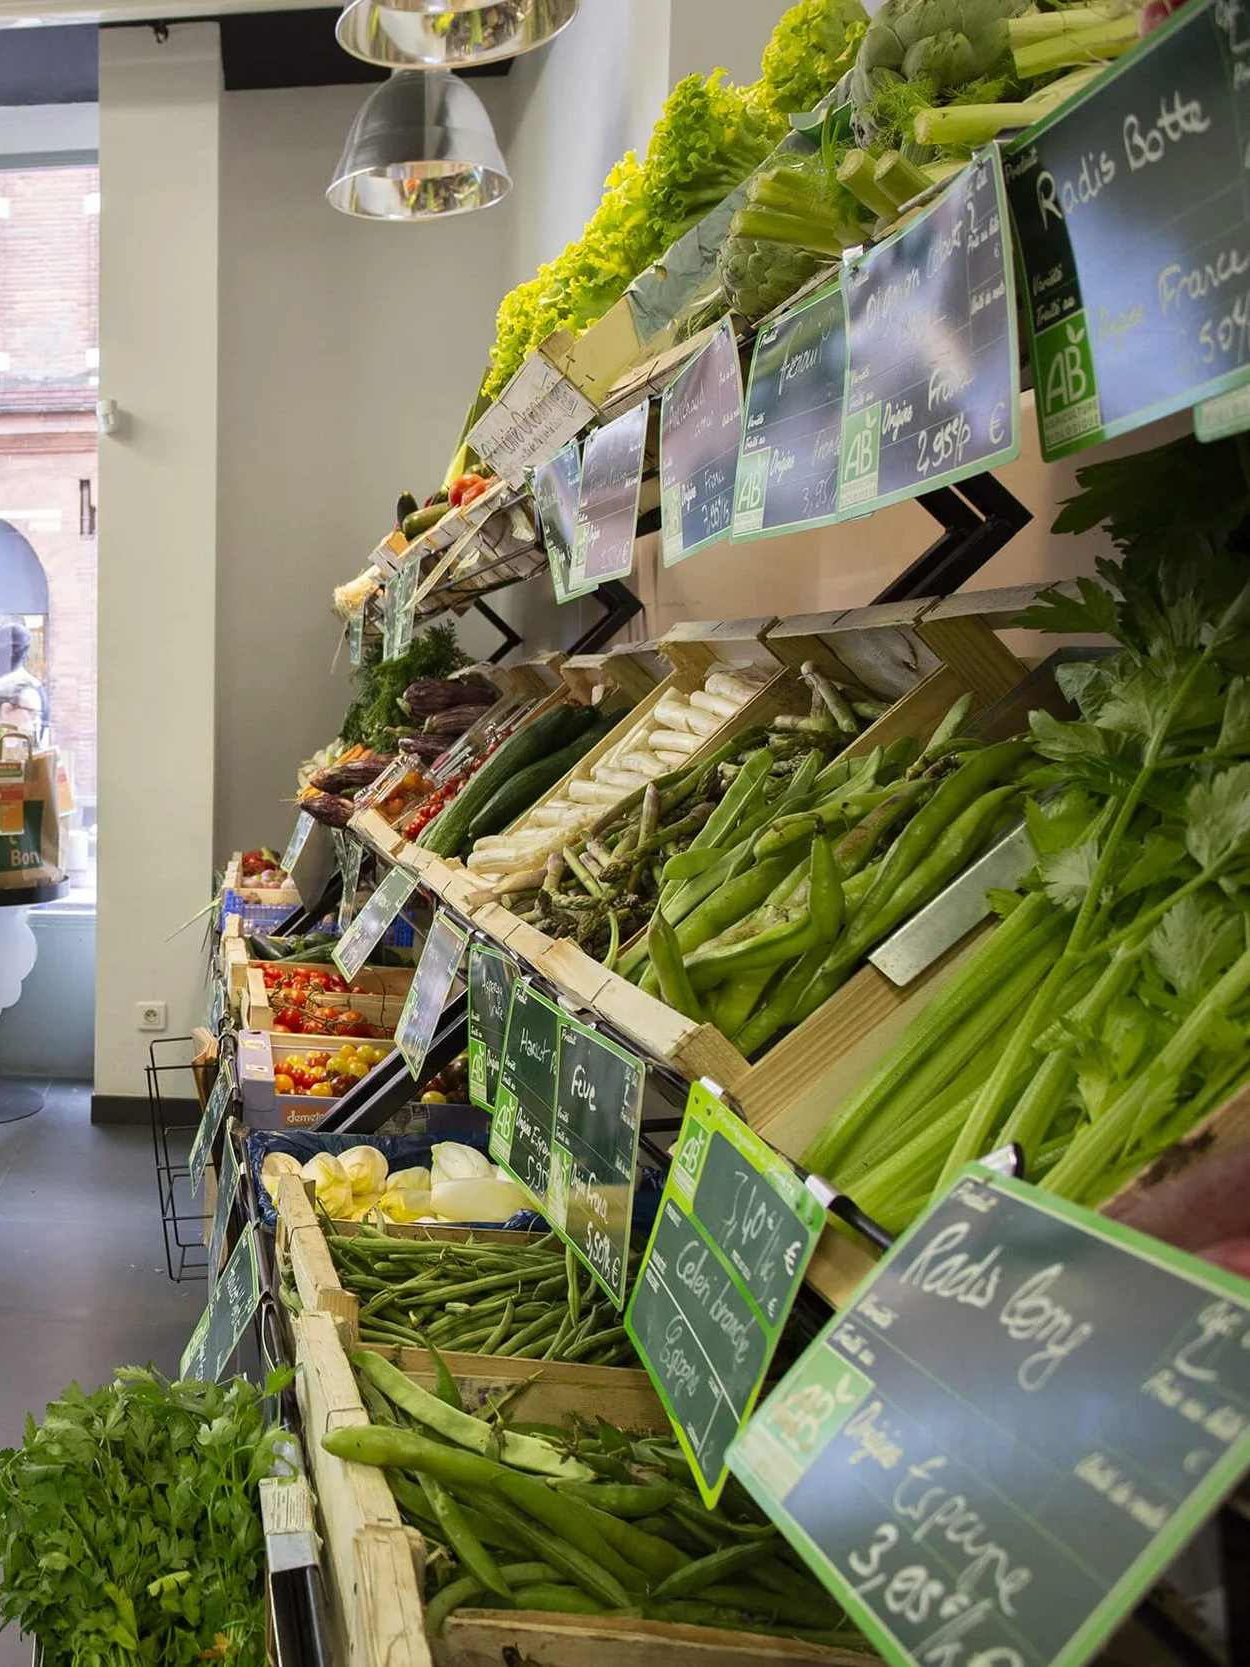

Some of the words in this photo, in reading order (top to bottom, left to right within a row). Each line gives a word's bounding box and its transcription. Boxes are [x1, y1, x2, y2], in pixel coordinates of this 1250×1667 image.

[1036, 150, 1117, 231] Radis
[1122, 91, 1211, 172] Botte
[988, 402, 1006, 445] €
[844, 430, 873, 481] AB
[737, 470, 761, 509] AB
[11, 848, 41, 867] Bon
[286, 1110, 326, 1123] demete
[611, 1256, 621, 1288] €
[783, 1241, 802, 1277] €
[898, 1221, 1003, 1309] Radis
